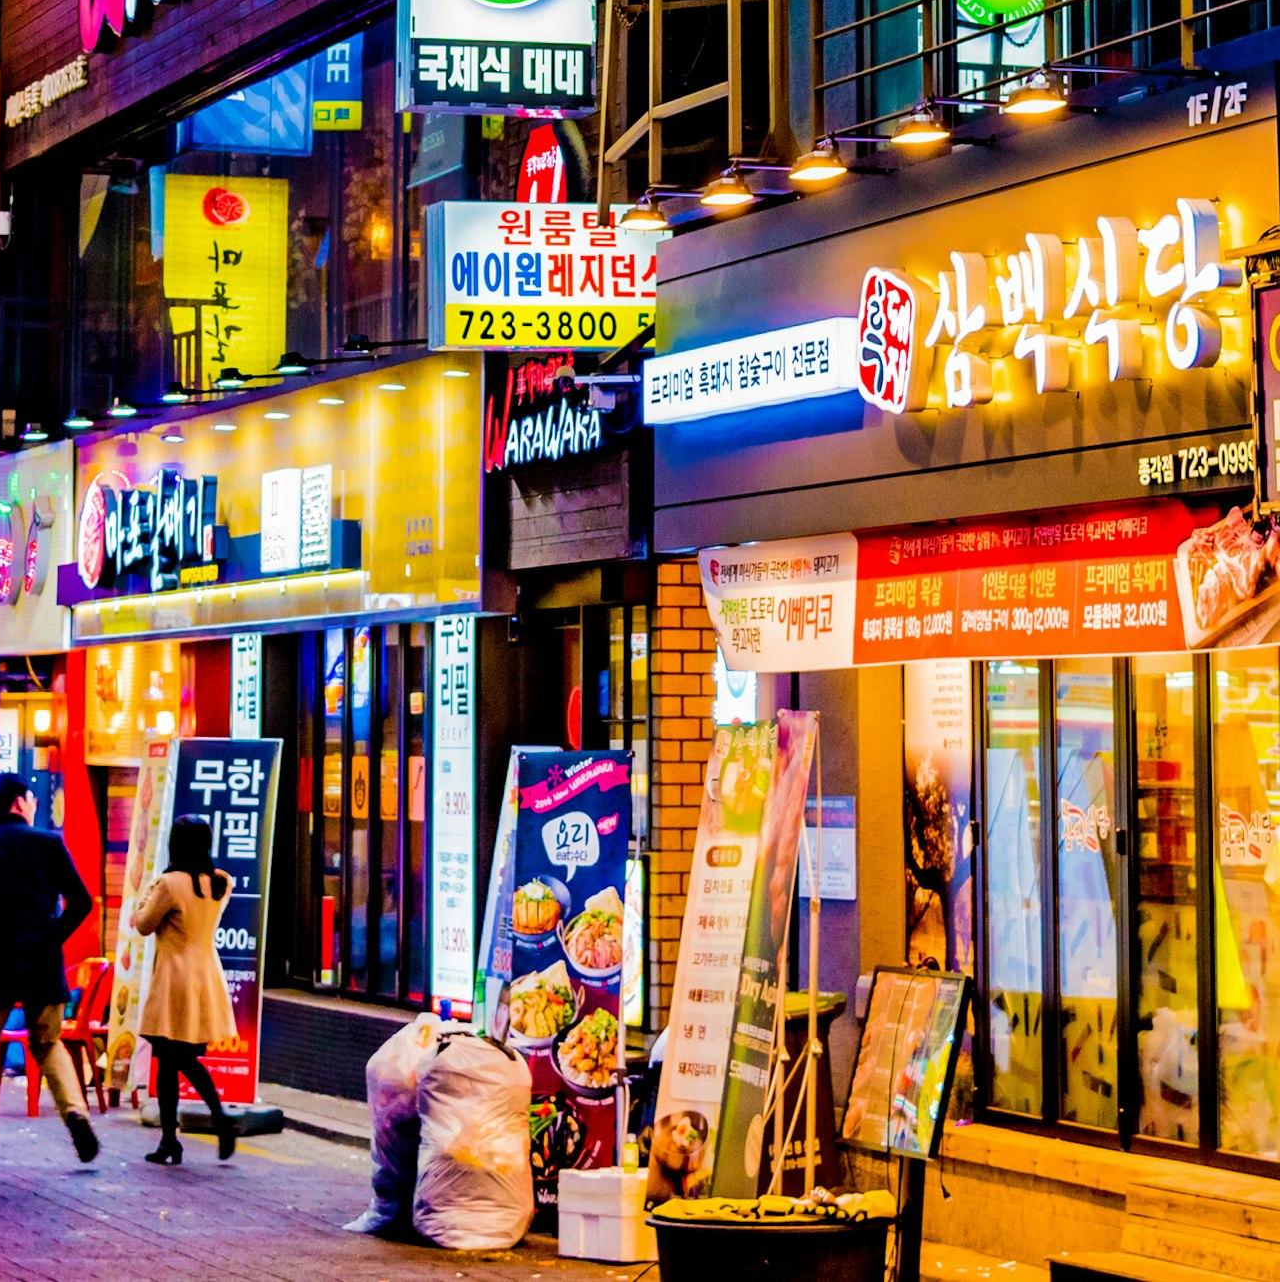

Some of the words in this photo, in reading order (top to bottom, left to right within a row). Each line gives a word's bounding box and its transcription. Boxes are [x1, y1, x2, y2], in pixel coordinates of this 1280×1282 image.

[419, 45, 510, 92] 국제식
[523, 47, 583, 96] 대대
[497, 209, 618, 247] 원룸텔
[924, 197, 1220, 409] 삼백식당
[458, 310, 618, 341] 723-3800
[651, 366, 695, 404] 프리미엄
[699, 357, 733, 395] 흑돼지
[737, 349, 787, 388] 참숯구이
[791, 336, 830, 378] 전문점
[1138, 454, 1175, 486] 종각점
[105, 468, 218, 593] 마포갈매기
[1118, 518, 1148, 539] 이베리코
[720, 564, 738, 585] 전세계
[813, 554, 840, 575] 돼지고기
[1084, 564, 1131, 595] 프리미엄
[1131, 559, 1168, 592] 흑돼지
[874, 579, 916, 608] 프리미엄
[981, 572, 1008, 601] 1인분
[749, 596, 774, 622] 도토리
[778, 593, 833, 642] 이베리코
[922, 610, 953, 636] 12,000원
[960, 609, 991, 634] 갈비양념
[992, 608, 1009, 631] 구이
[1011, 608, 1032, 636] 300g
[1032, 605, 1070, 631] 12,000원
[1123, 599, 1168, 627] 32,000원
[439, 664, 469, 716] 리필
[190, 758, 266, 807] 무한
[564, 756, 595, 778] Winter
[533, 793, 553, 810] 2016
[552, 786, 570, 803] New
[568, 761, 615, 793] WARAWARA
[554, 819, 589, 850] 요리
